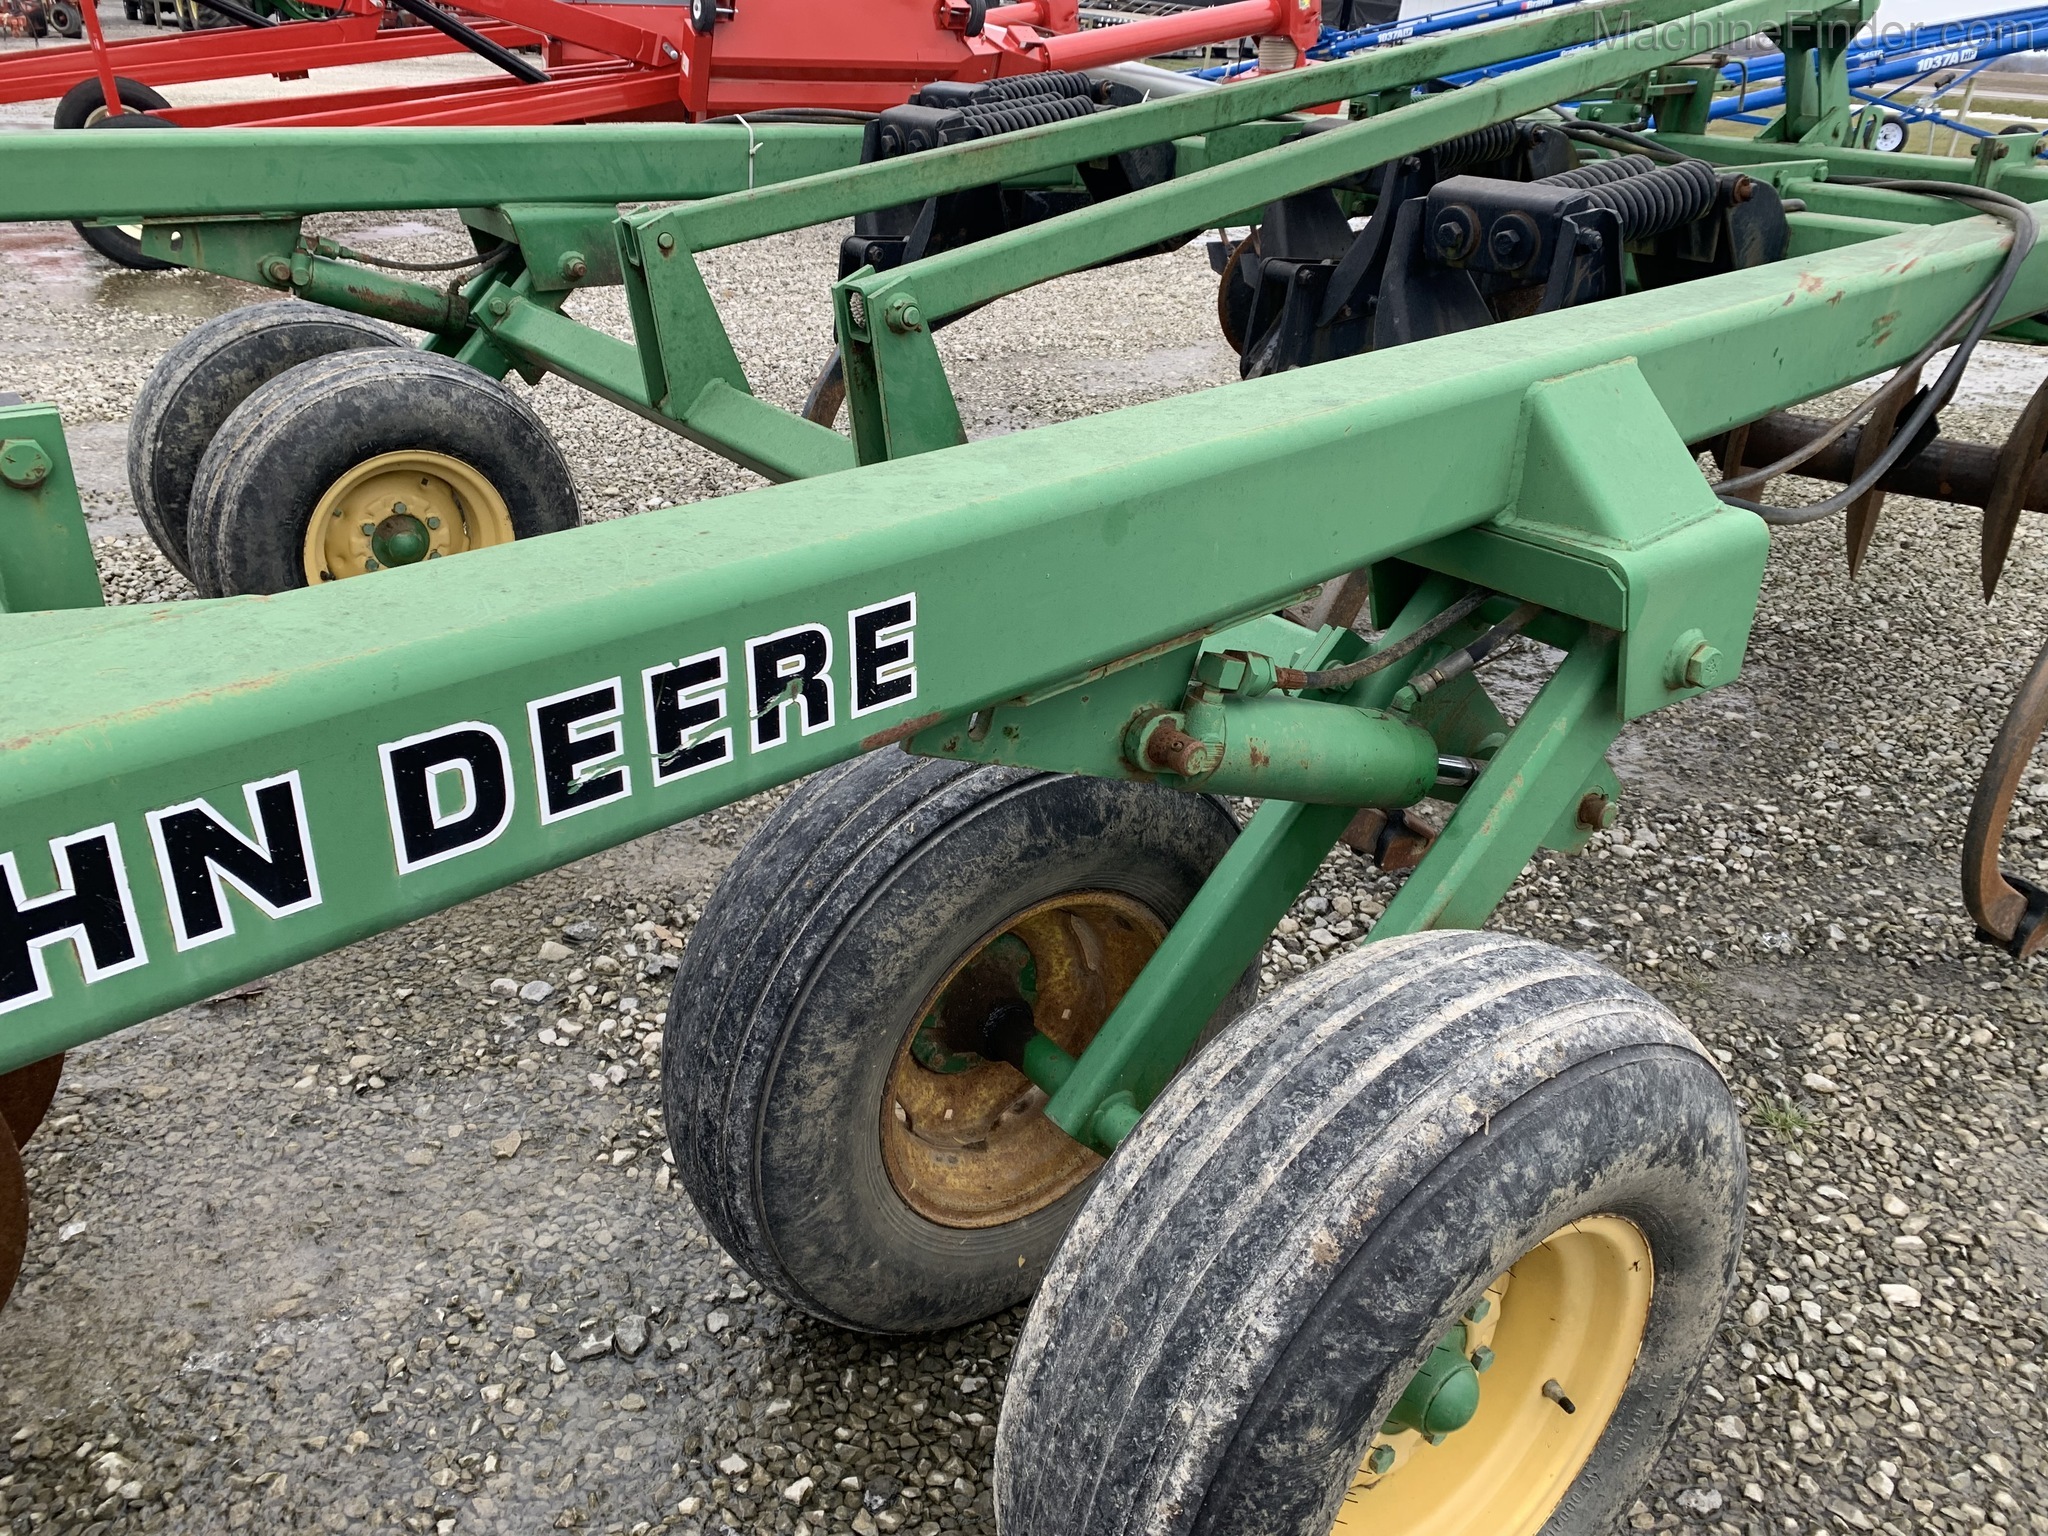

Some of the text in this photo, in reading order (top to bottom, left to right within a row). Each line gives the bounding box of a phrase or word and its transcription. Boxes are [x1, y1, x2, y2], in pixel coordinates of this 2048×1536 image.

[1377, 29, 1402, 43] 1037A
[1917, 49, 1976, 72] 1037A HP
[378, 591, 918, 876] DEERE
